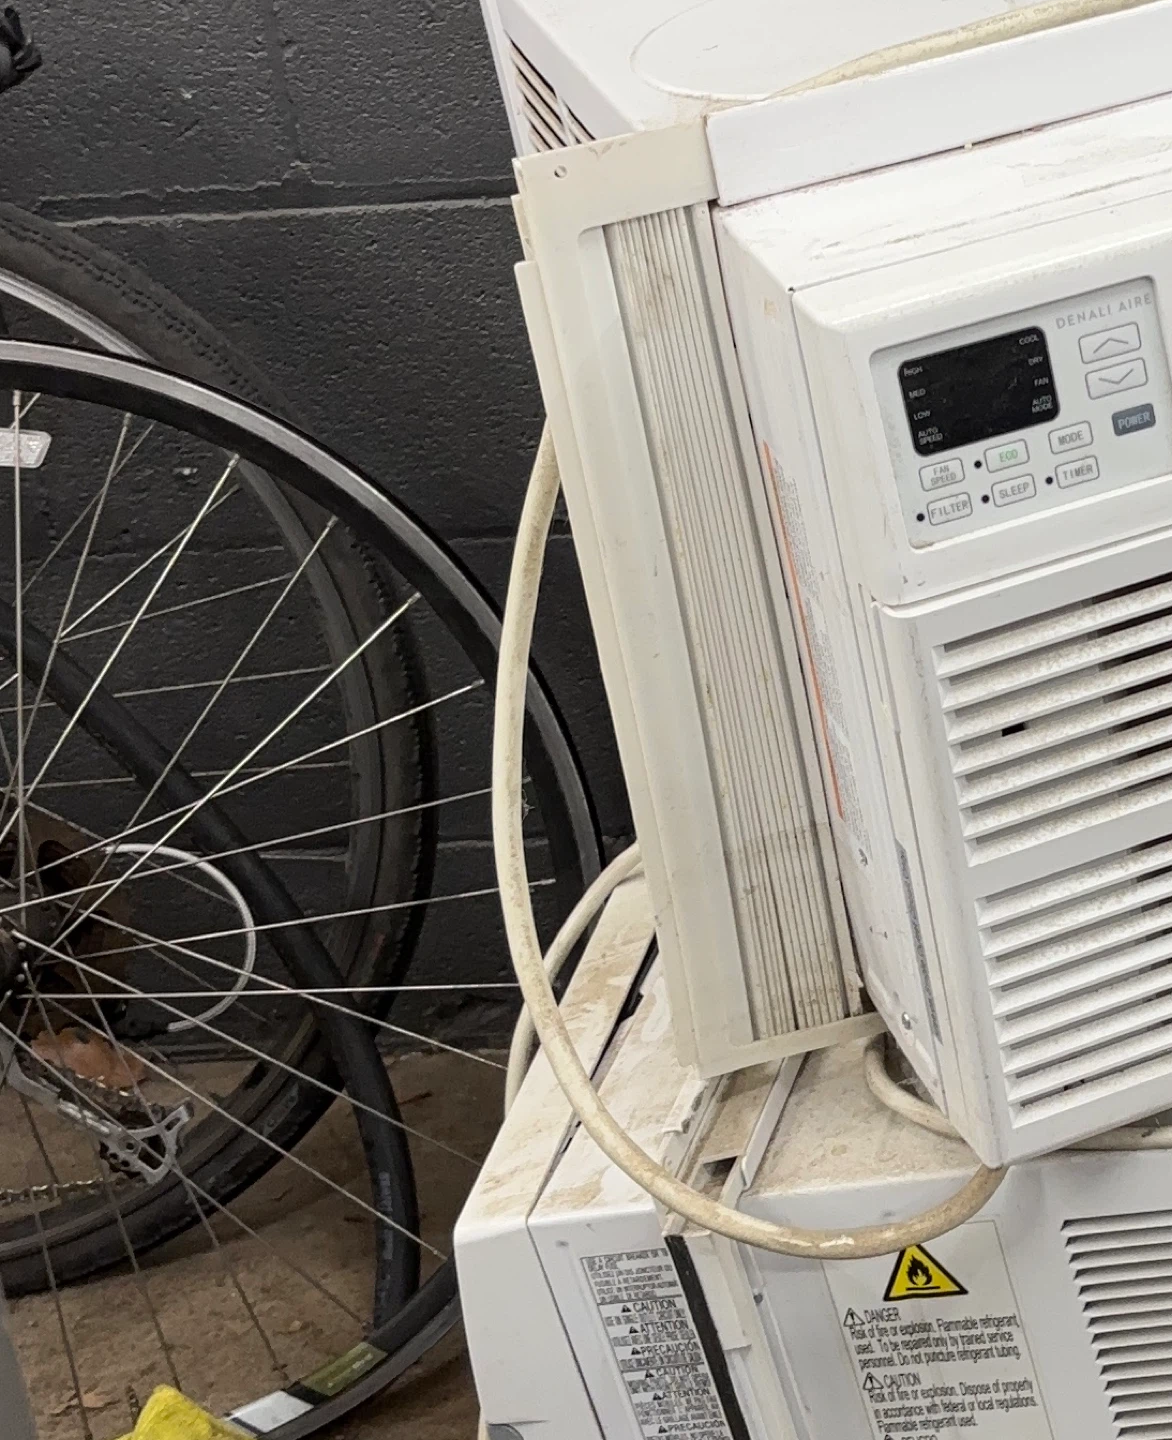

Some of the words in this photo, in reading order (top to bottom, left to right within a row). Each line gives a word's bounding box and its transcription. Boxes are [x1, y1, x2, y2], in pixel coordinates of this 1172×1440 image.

[1056, 304, 1112, 329] DENALI
[1119, 293, 1152, 313] AIRE
[1019, 334, 1040, 346] COOL
[1028, 356, 1044, 366] DRY
[1034, 376, 1049, 387] FAN
[909, 388, 926, 399] MED
[1032, 395, 1053, 406] AUTO
[1032, 401, 1054, 413] MODE
[914, 410, 931, 421] LOW
[1117, 411, 1151, 429] POWER
[917, 426, 939, 438] AUTO
[919, 432, 944, 445] SPEED
[1058, 430, 1084, 445] MODE
[999, 449, 1019, 462] ECO
[933, 464, 950, 476] FAN
[1062, 464, 1094, 480] TIMER
[930, 471, 957, 486] SPEED
[998, 482, 1030, 499] SLEEP
[930, 499, 970, 519] FILTER
[631, 1297, 677, 1312] CAUTION
[864, 1307, 900, 1323] DANGER
[637, 1318, 689, 1333] ATTENTION
[638, 1339, 700, 1356] PRECAUCIÓN
[883, 1372, 921, 1388] CAUTION
